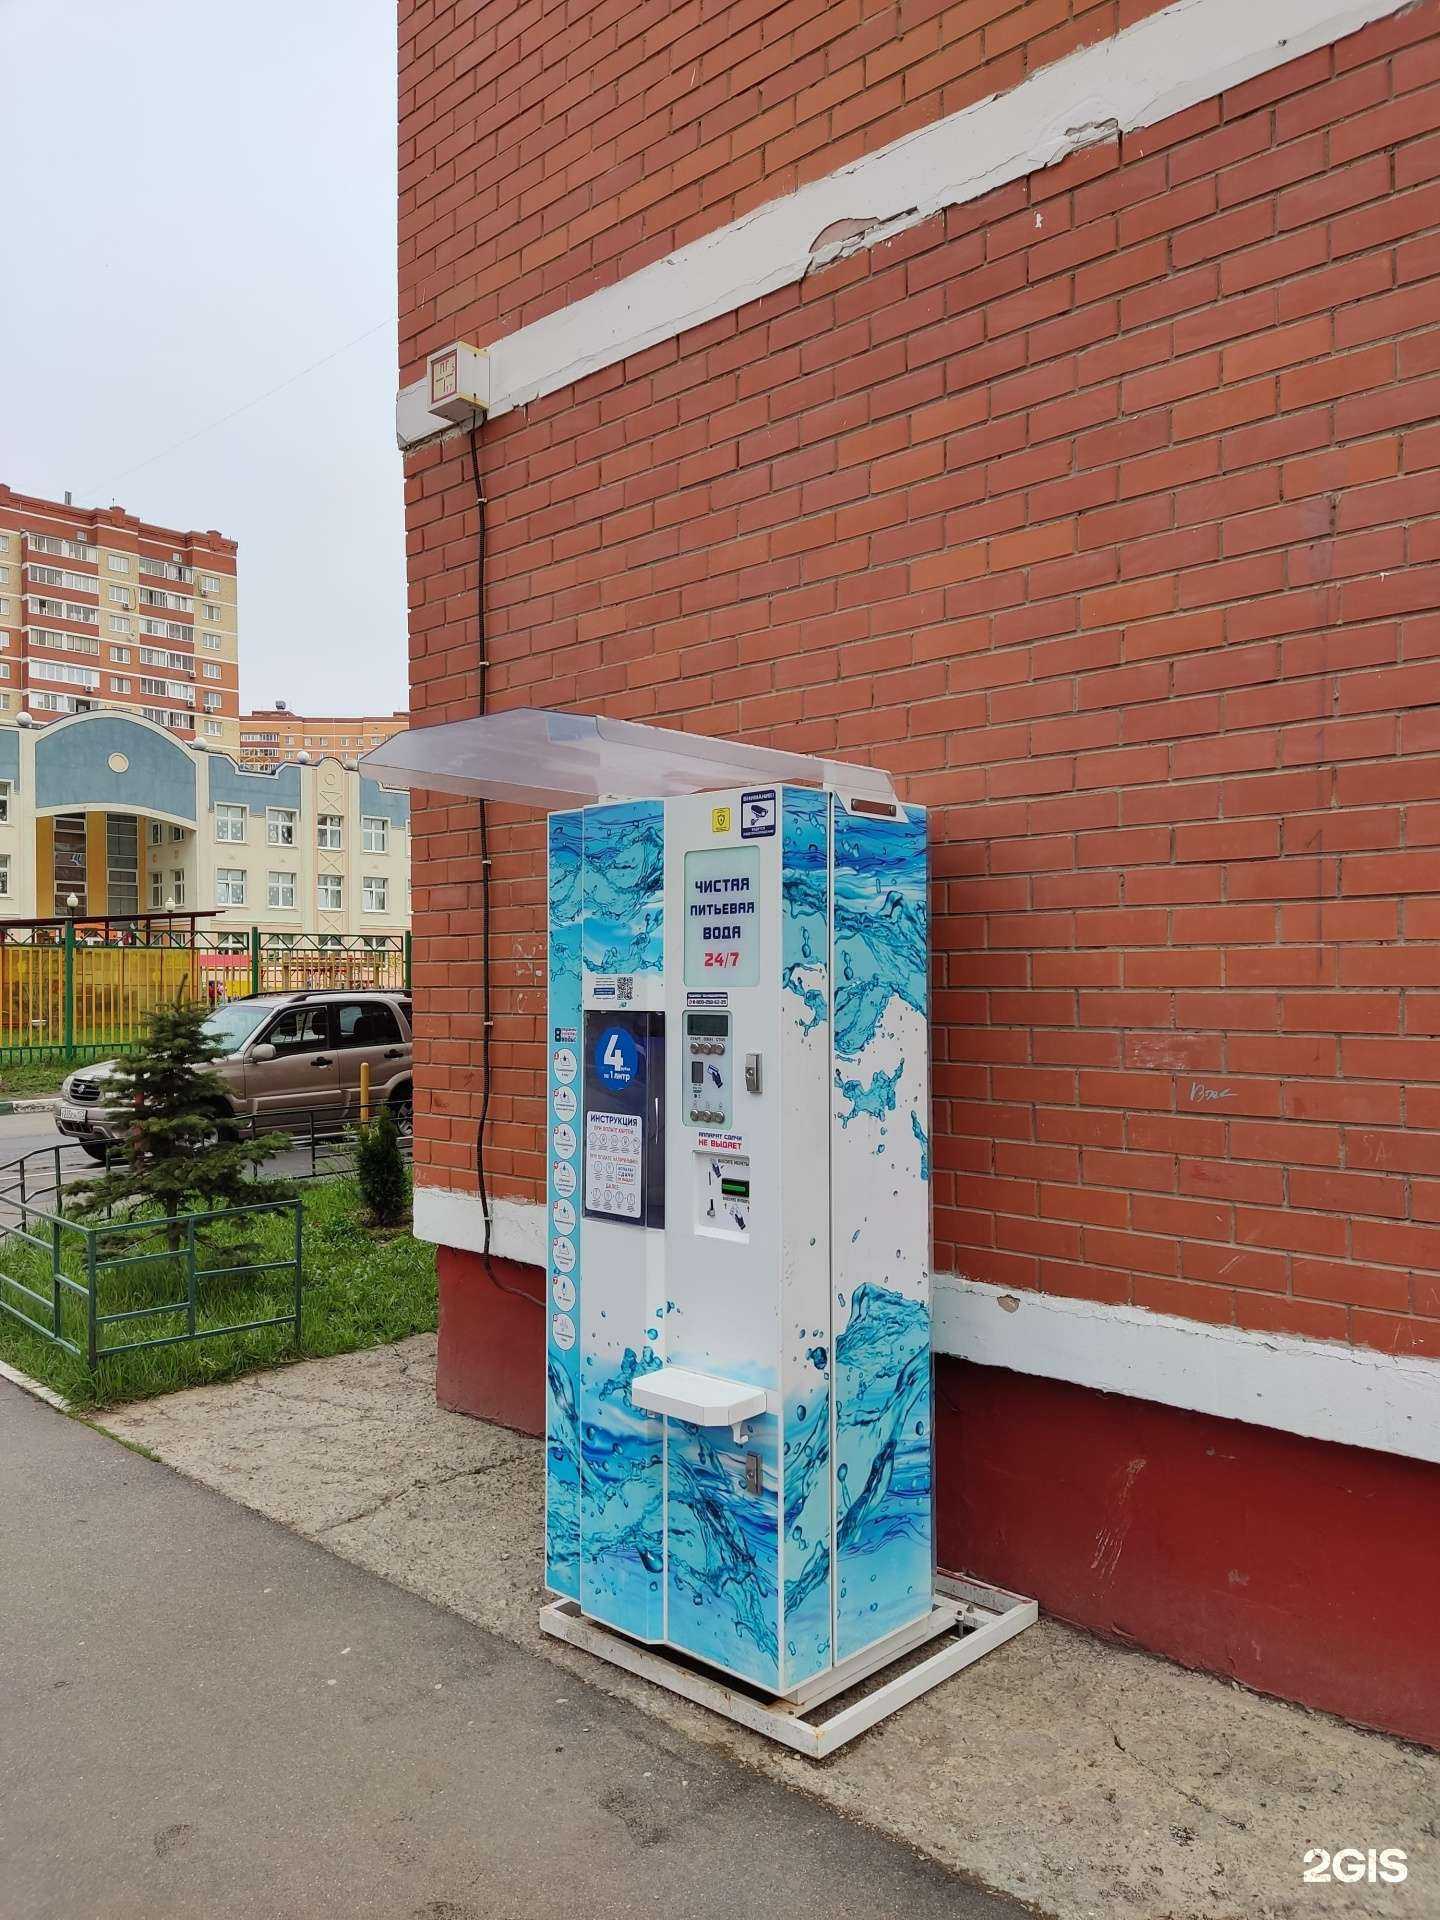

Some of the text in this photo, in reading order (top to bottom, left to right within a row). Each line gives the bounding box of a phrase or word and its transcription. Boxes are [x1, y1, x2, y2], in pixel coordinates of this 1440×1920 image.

[695, 877, 750, 894] ЧИСТАЯ
[690, 901, 755, 917] ПИТЬЕВАЯ
[703, 925, 741, 940] ВОДА
[704, 951, 740, 969] 24/7
[603, 1034, 624, 1072] 4
[614, 1072, 631, 1083] литр
[590, 1114, 638, 1127] ИНСТРУКЦИЯ
[710, 1140, 743, 1150] ВЫДАЕТ
